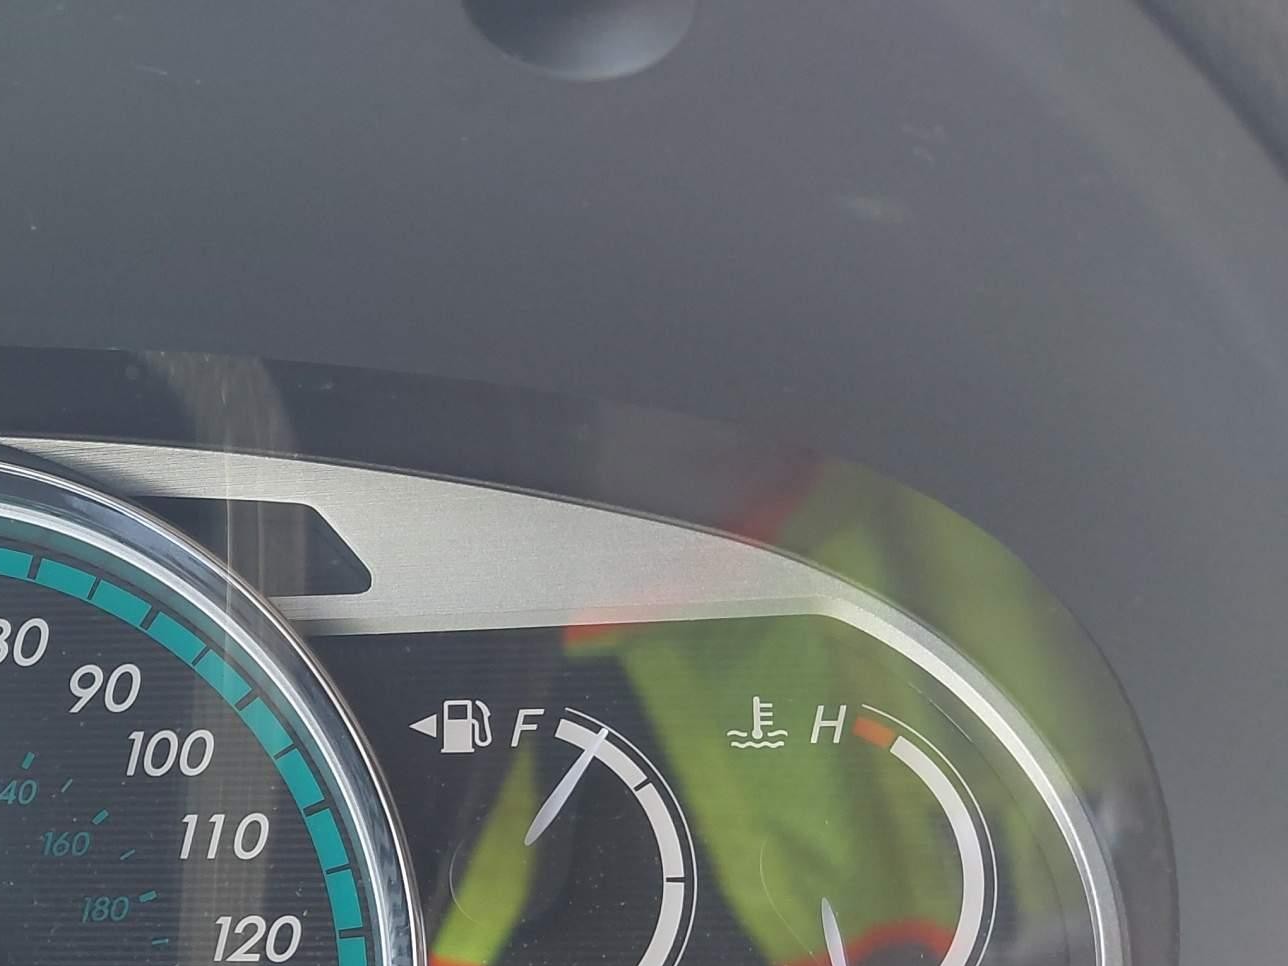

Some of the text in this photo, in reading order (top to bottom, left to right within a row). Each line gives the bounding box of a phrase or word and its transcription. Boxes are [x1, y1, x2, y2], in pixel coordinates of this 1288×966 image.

[70, 664, 141, 712] 90
[512, 709, 544, 746] F
[811, 705, 846, 743] H
[127, 730, 214, 776] 100
[42, 832, 90, 857] 160
[180, 813, 269, 859] 110
[82, 896, 130, 923] 180
[214, 916, 301, 962] 120
